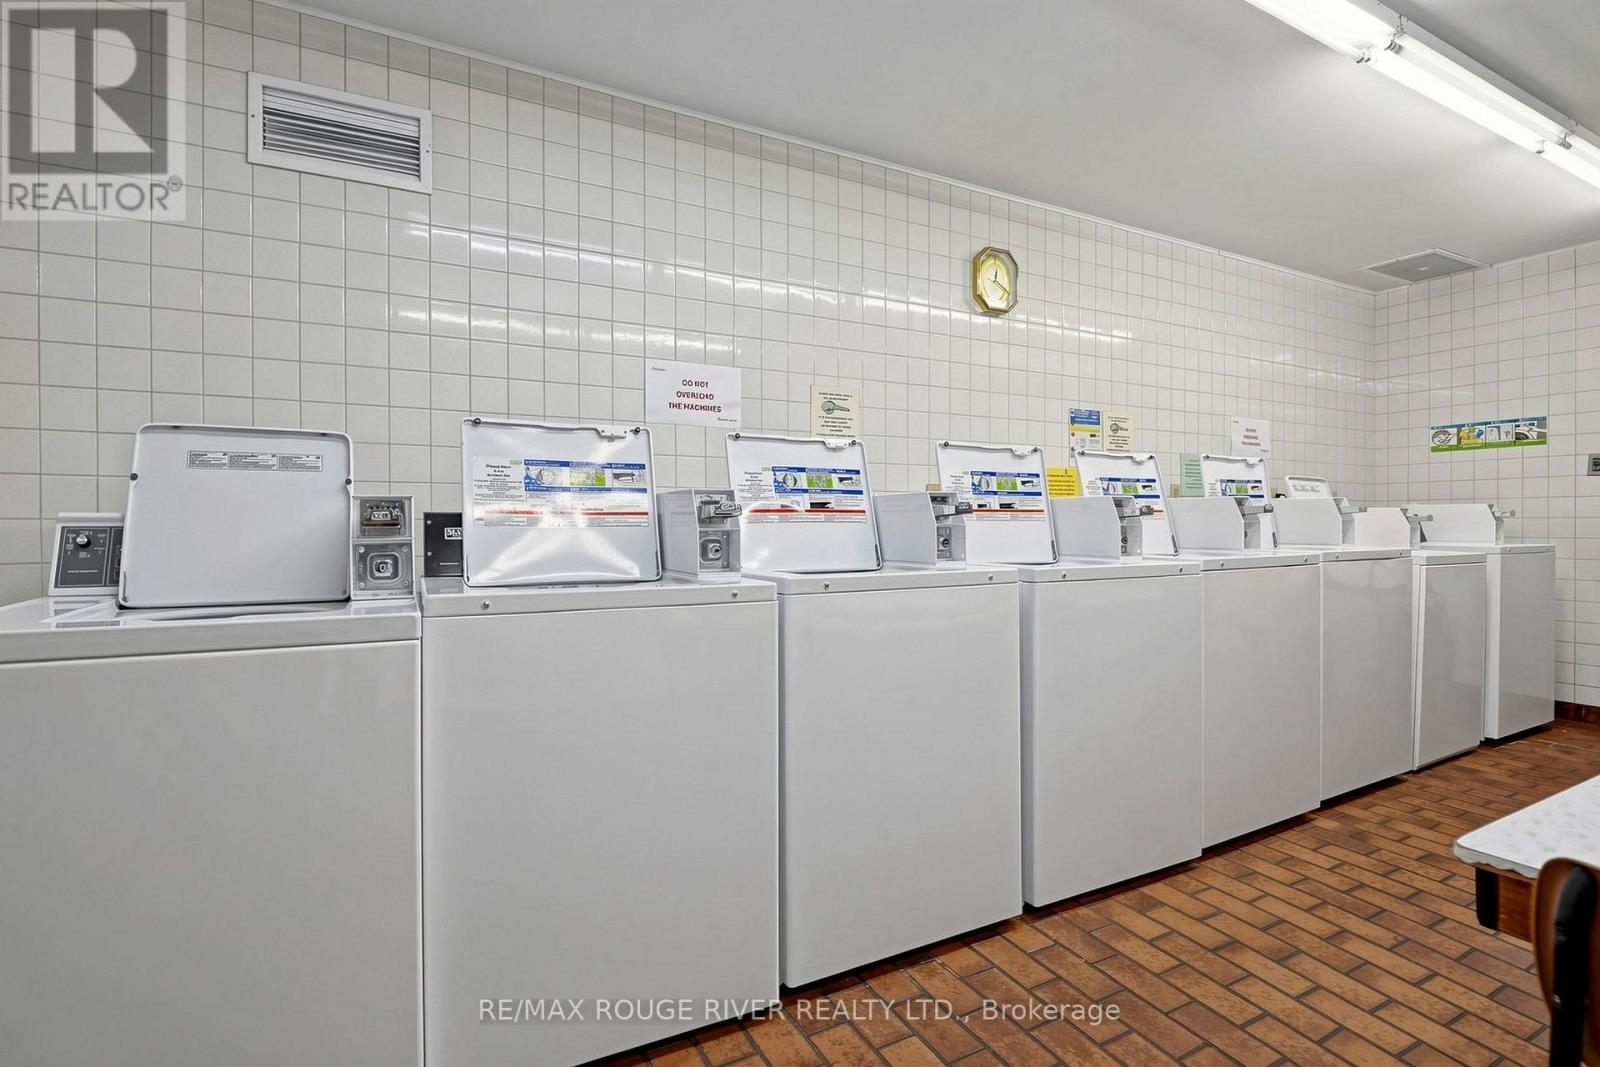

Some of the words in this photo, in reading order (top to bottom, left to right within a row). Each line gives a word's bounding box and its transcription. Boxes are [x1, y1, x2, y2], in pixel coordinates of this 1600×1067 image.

[682, 379, 693, 387] DO
[694, 380, 709, 388] NOT
[676, 391, 714, 400] OVERLOAD
[668, 402, 683, 410] THE
[684, 404, 721, 412] MACHINES
